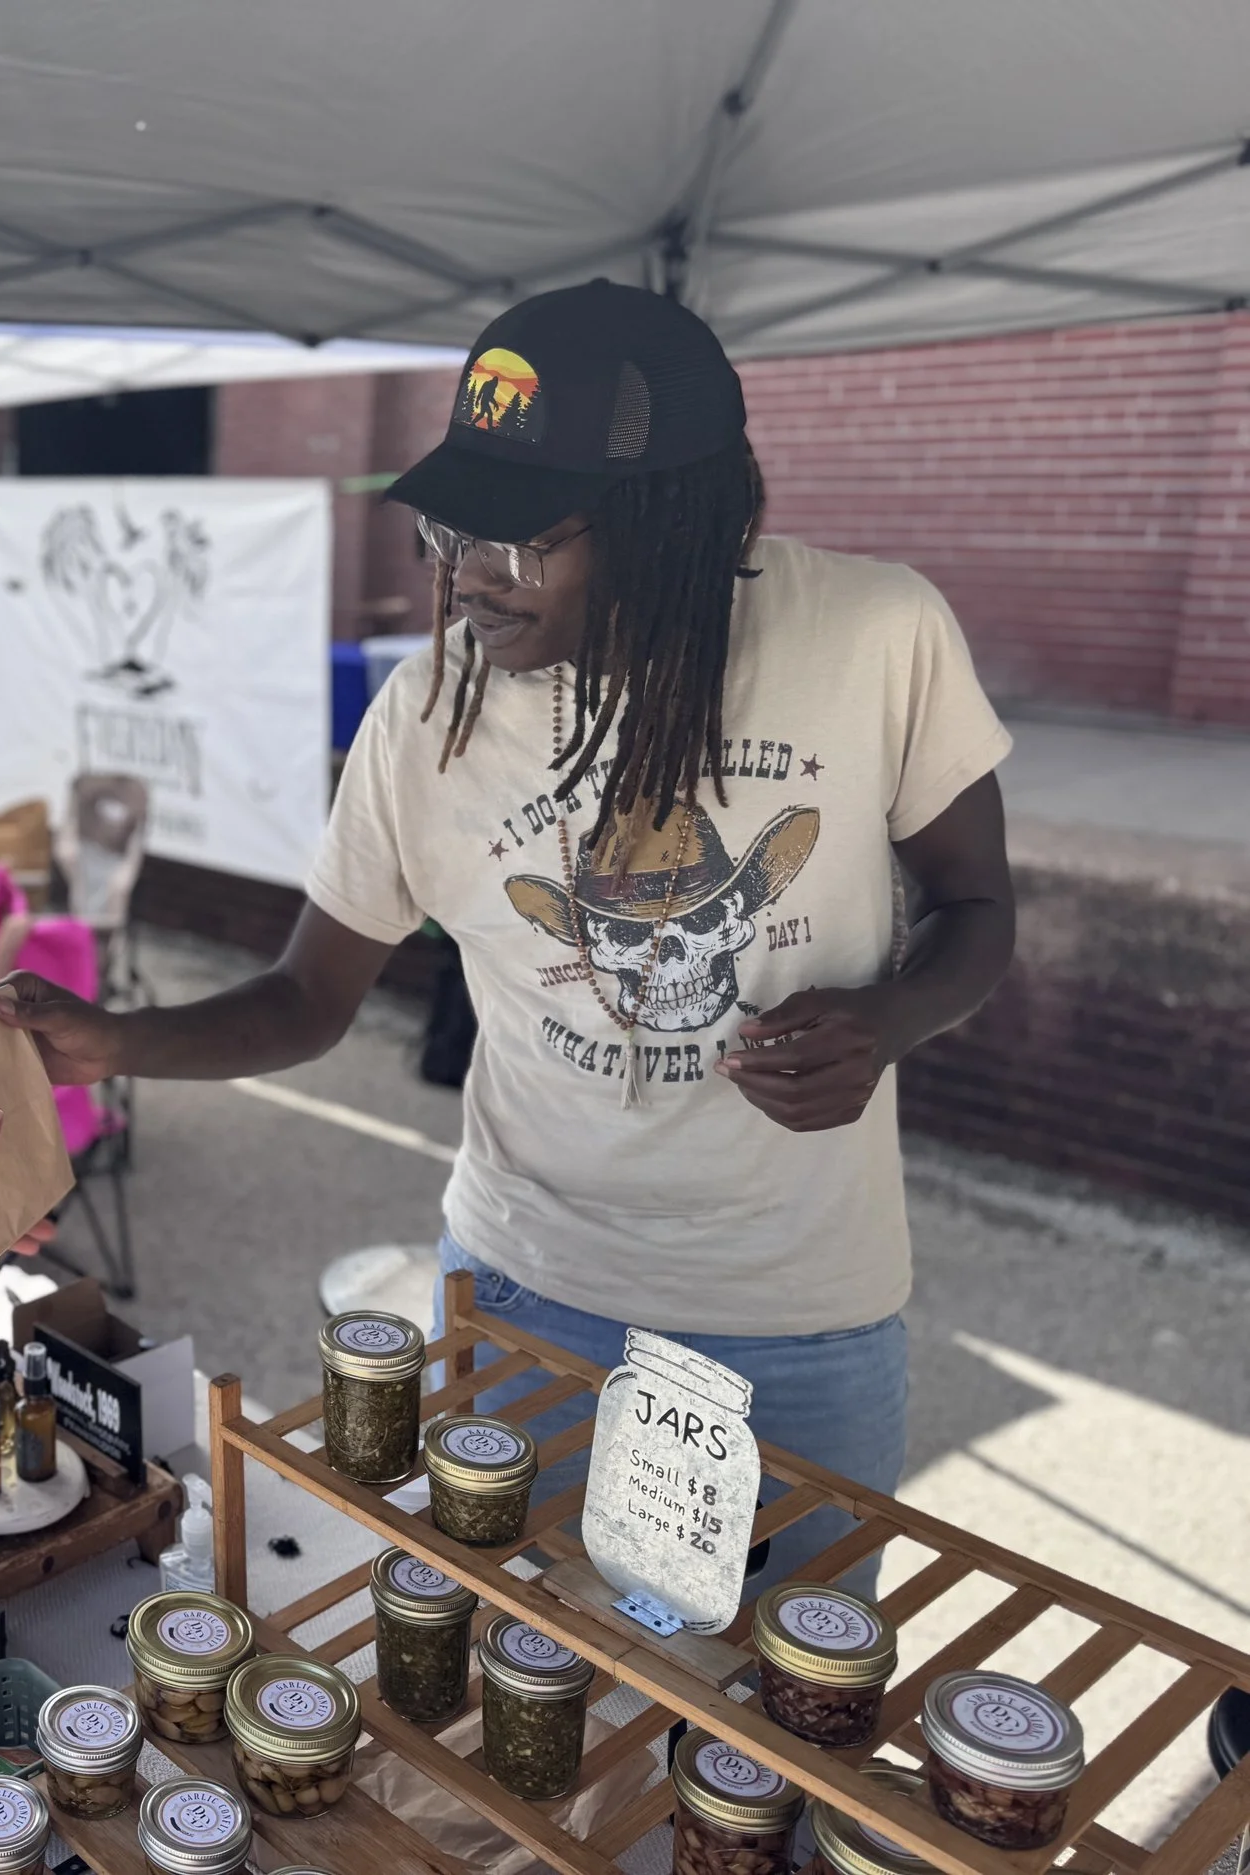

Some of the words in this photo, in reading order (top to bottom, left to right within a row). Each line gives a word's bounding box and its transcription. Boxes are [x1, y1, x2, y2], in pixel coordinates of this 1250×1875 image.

[702, 739, 792, 780] ALLED
[503, 818, 524, 848] I
[522, 794, 556, 835] DO
[766, 919, 799, 951] DAY
[804, 916, 811, 943] 1
[536, 962, 587, 987] SINCE
[97, 1388, 121, 1433] 1969
[635, 1389, 727, 1460] JARS
[630, 1449, 679, 1487] Small
[629, 1475, 685, 1516] Medium
[628, 1498, 670, 1533] Large
[184, 1611, 218, 1623] GARLIC
[208, 1625, 225, 1647] CONFIT
[791, 1600, 835, 1613] SWEET
[839, 1610, 862, 1640] ONIONS
[276, 1681, 313, 1691] GARLIC
[314, 1689, 328, 1717] CONFIT
[966, 1693, 1017, 1706] SWEET
[1021, 1706, 1046, 1740] ONIONS
[74, 1702, 109, 1713] GARLIC
[110, 1710, 123, 1737] CONFIT
[14, 1801, 29, 1829] CONFIT
[180, 1792, 220, 1804] GARLIC
[217, 1804, 232, 1834] CONFIT
